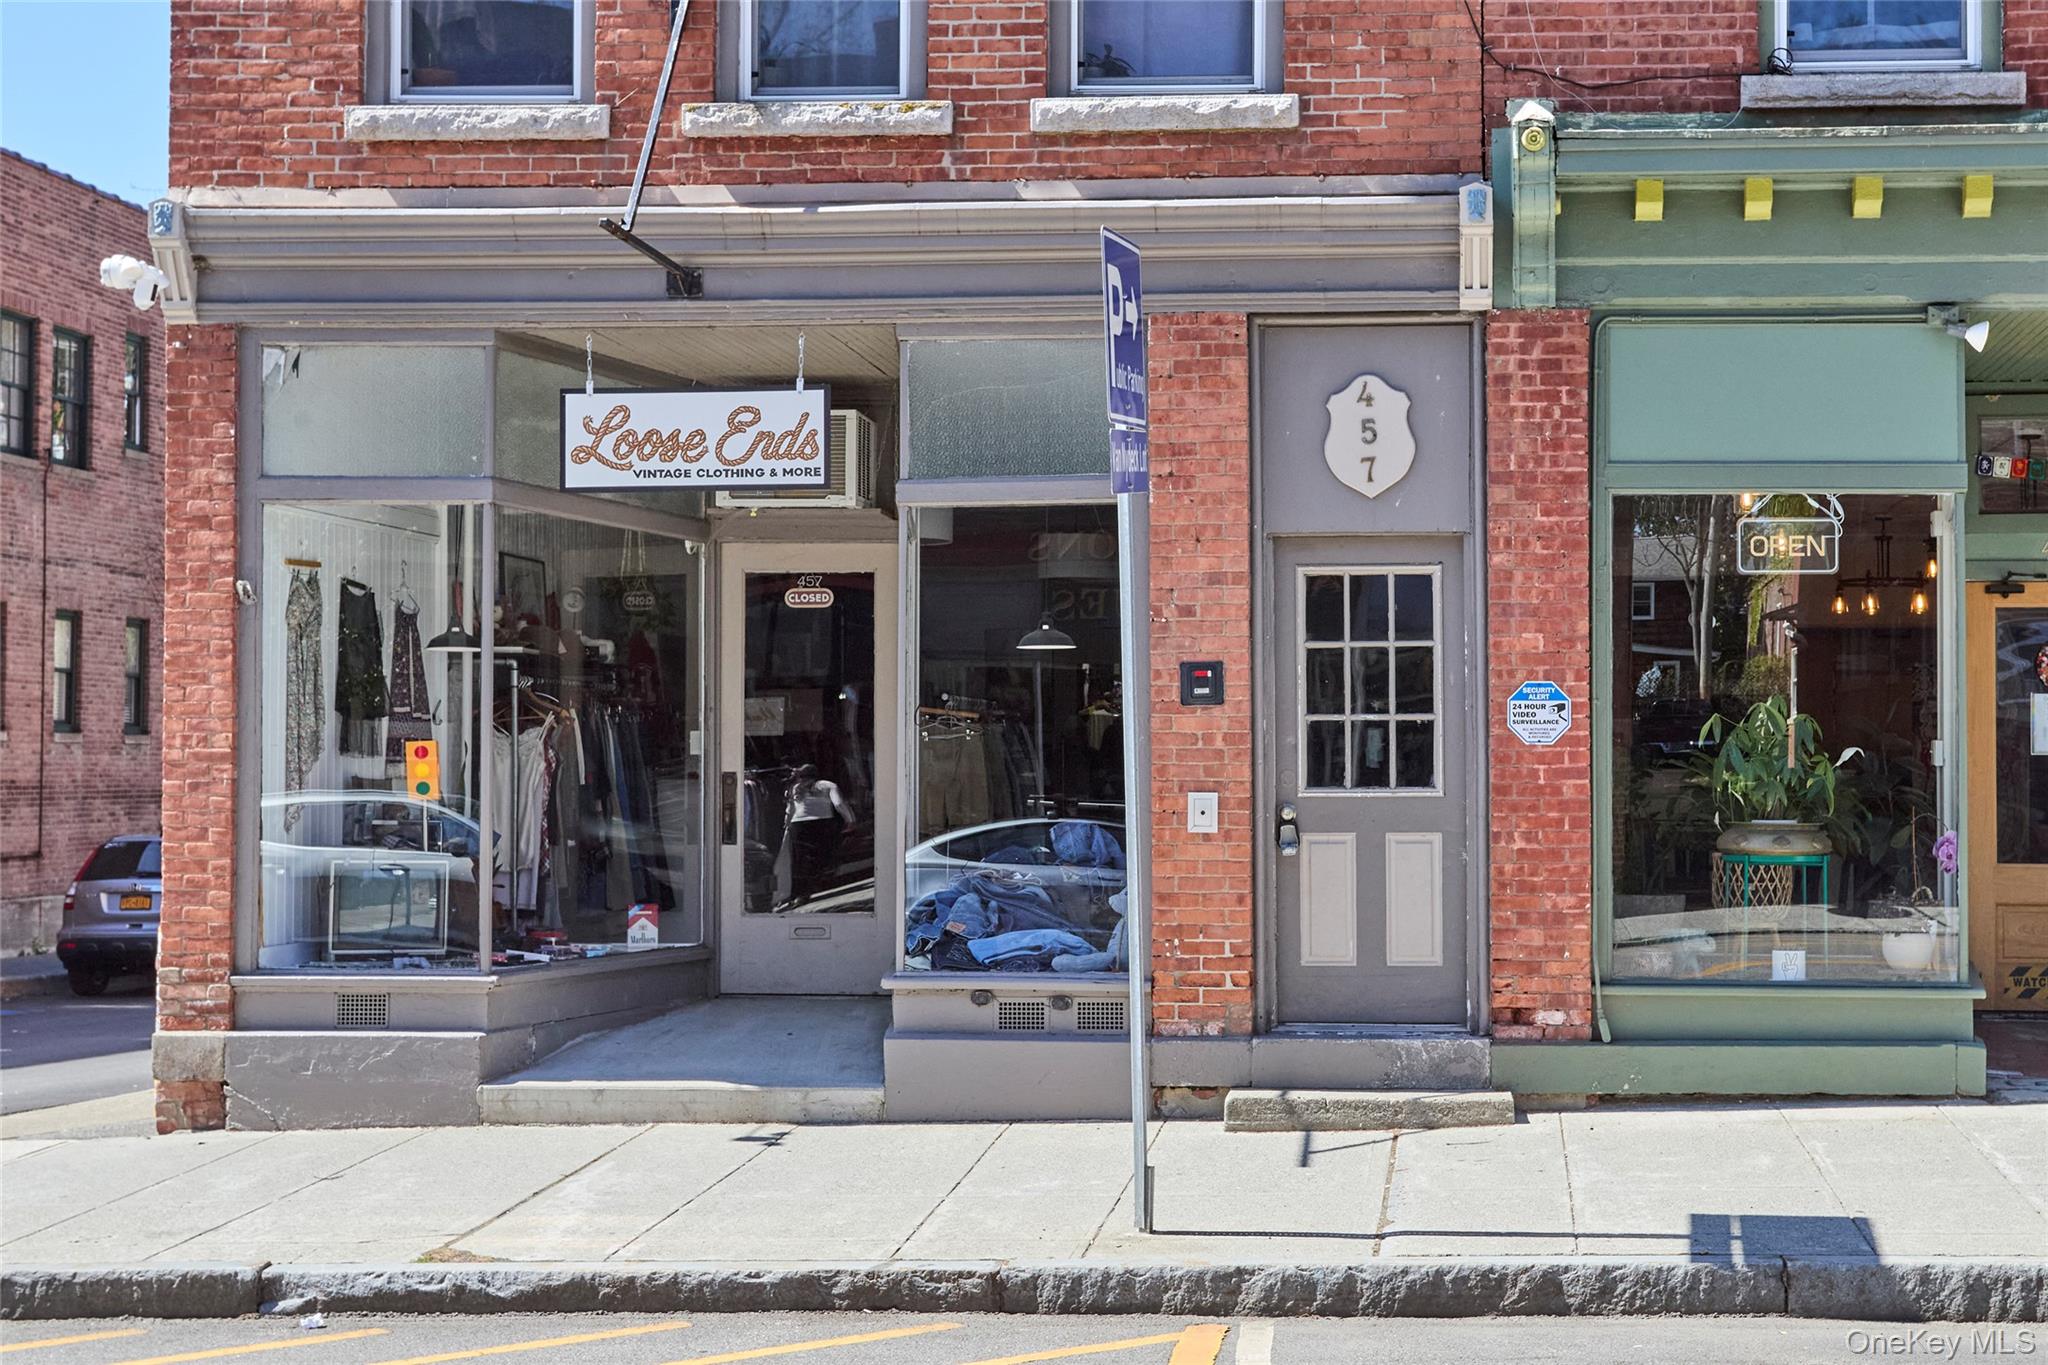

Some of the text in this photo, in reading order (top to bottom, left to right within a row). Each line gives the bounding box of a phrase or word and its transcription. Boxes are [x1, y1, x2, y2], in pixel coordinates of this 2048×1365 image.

[571, 404, 819, 471] Loose Ends
[633, 466, 822, 479] VINTAGE CLOTHING & MORE
[1749, 535, 1826, 557] OPEN
[797, 575, 823, 587] 457
[788, 593, 830, 603] CLOSED
